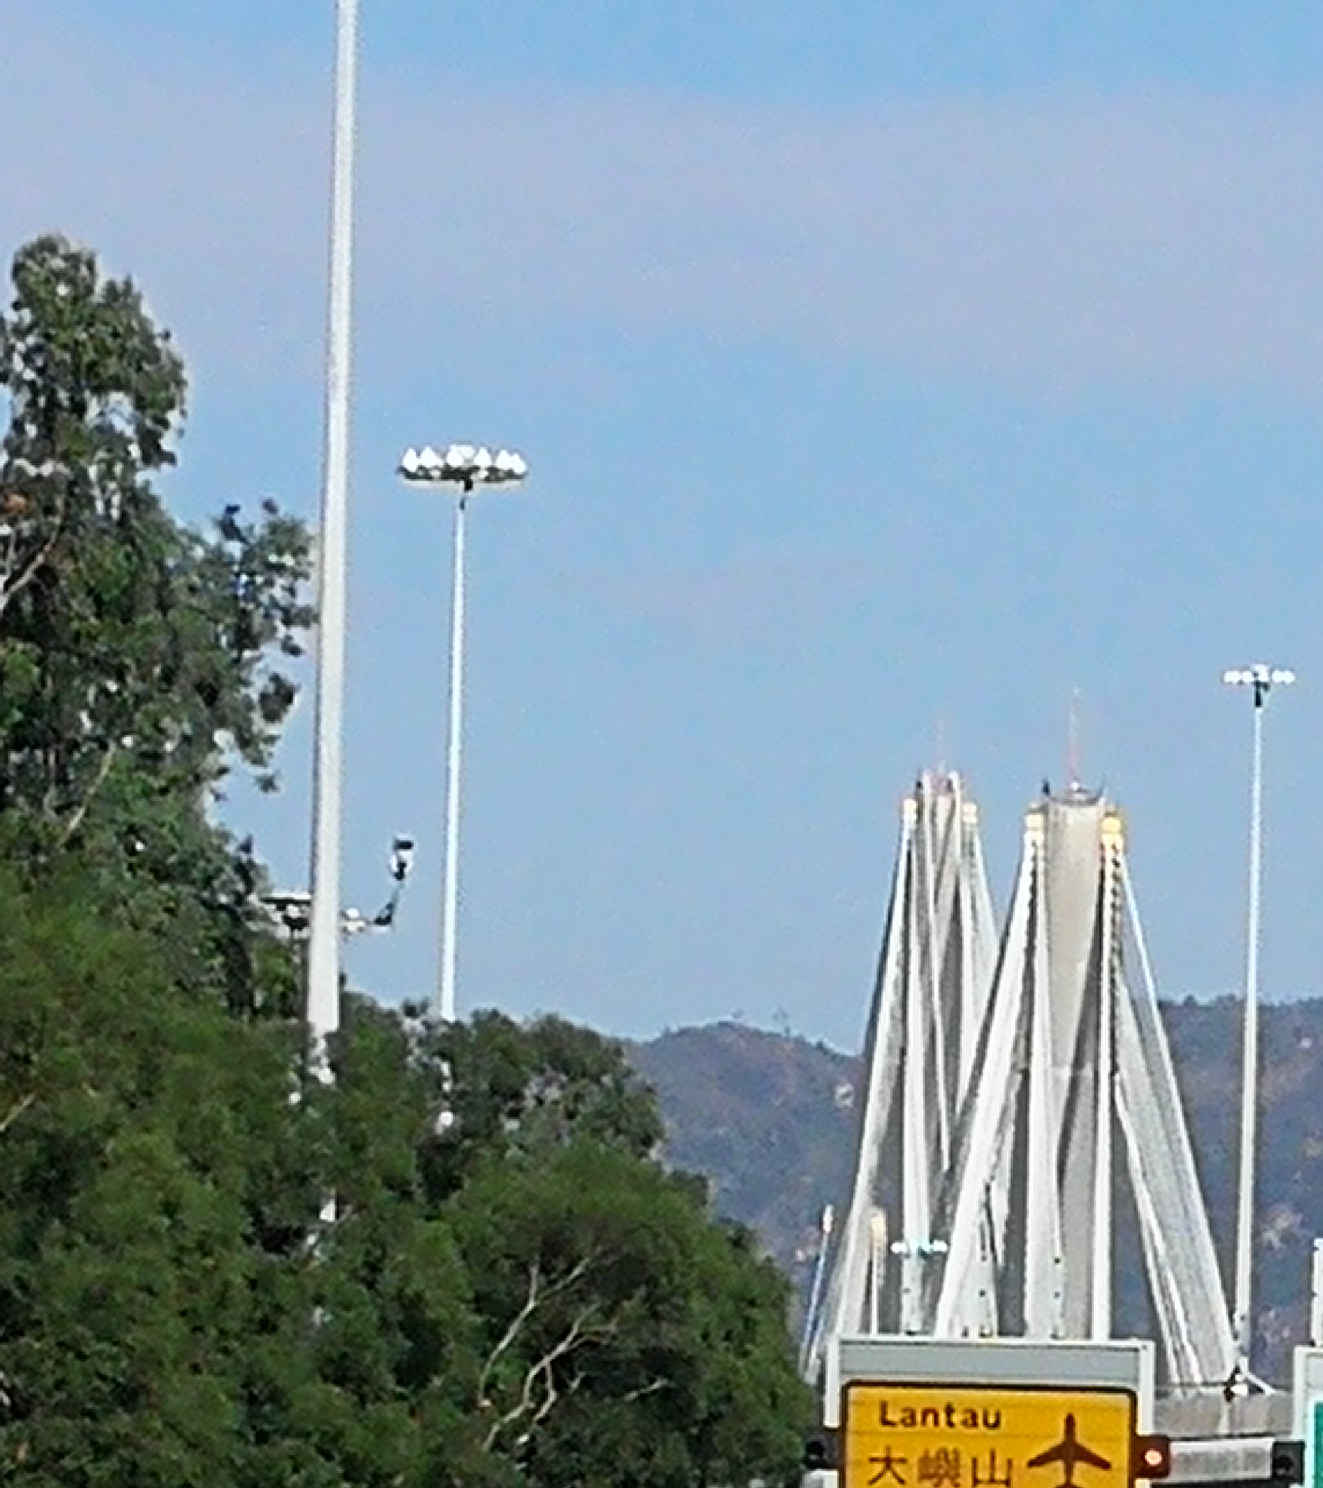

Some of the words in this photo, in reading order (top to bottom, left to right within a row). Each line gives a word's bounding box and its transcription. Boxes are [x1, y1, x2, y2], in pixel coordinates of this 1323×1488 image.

[880, 1401, 1001, 1429] Lantau
[867, 1446, 1013, 1488] 大嶼山
